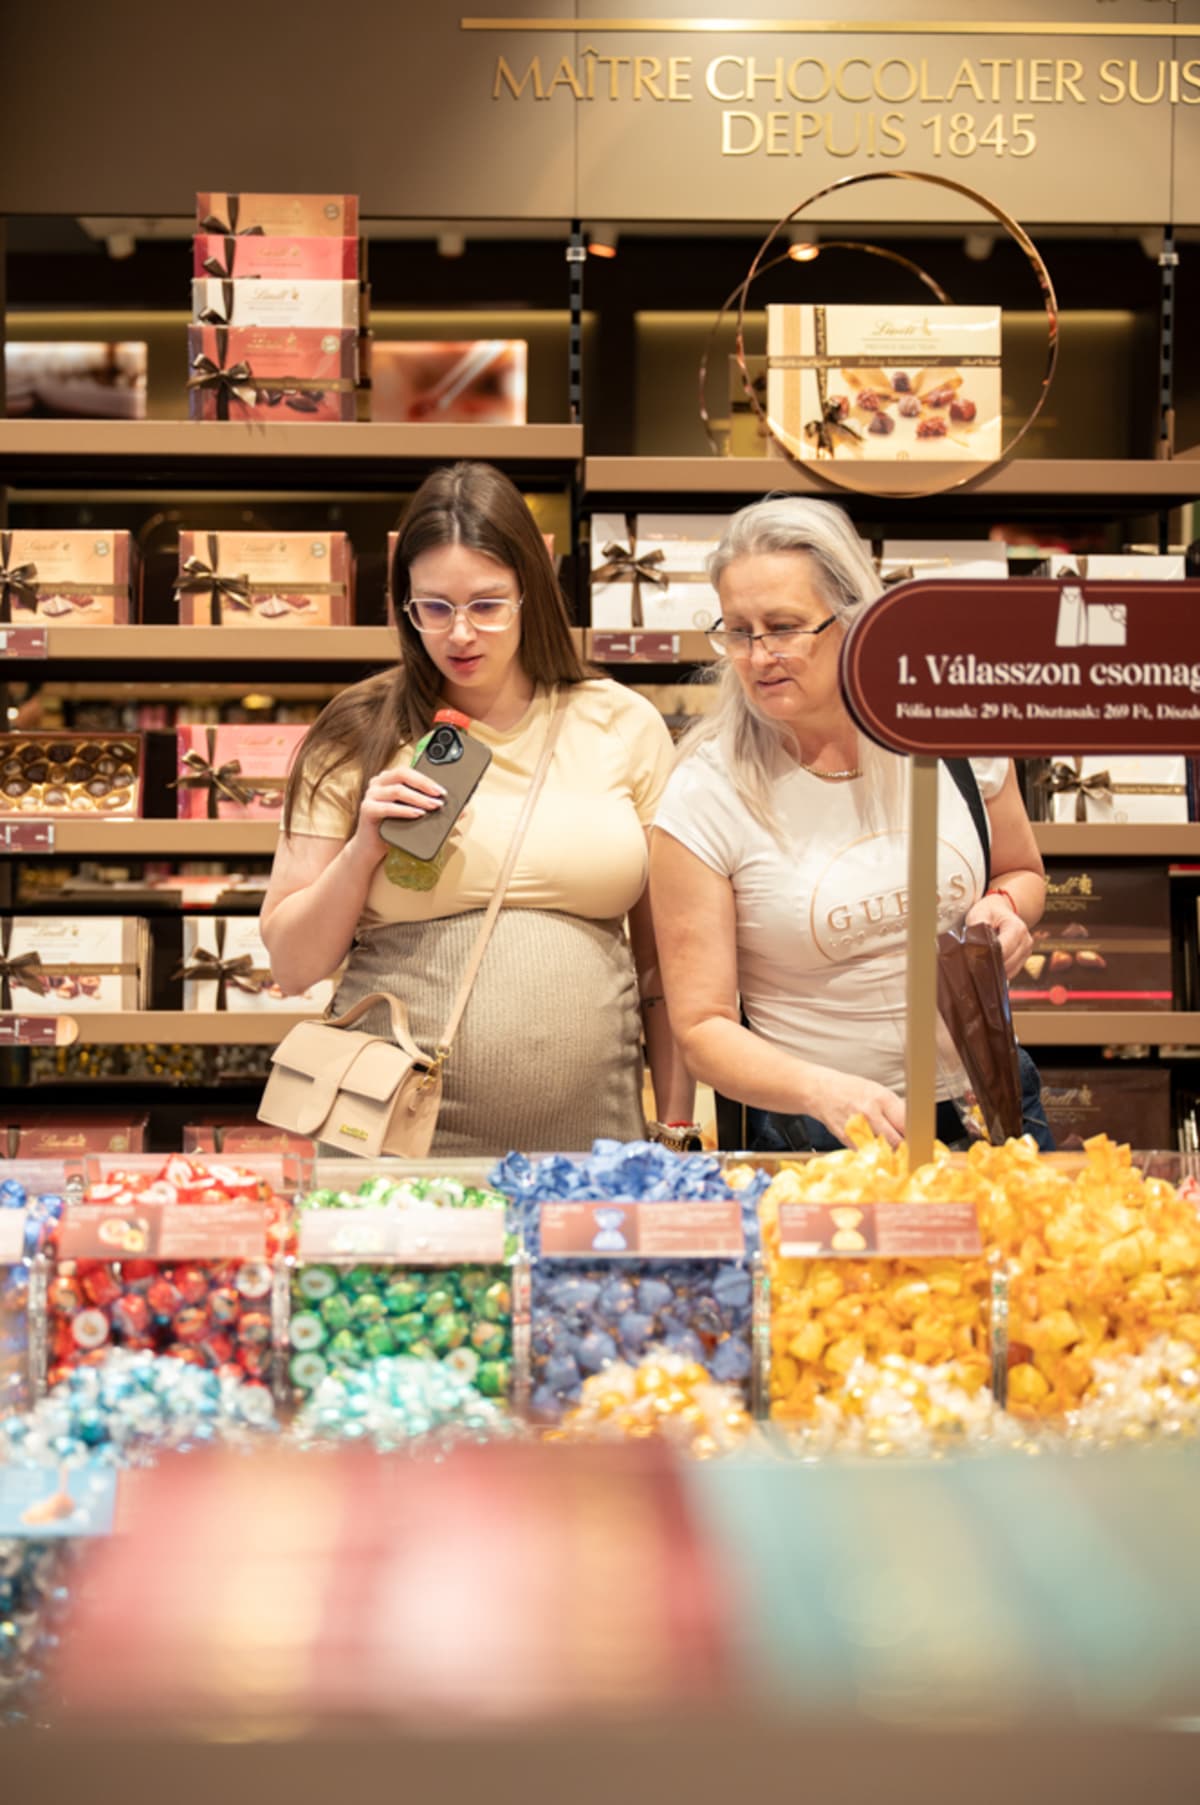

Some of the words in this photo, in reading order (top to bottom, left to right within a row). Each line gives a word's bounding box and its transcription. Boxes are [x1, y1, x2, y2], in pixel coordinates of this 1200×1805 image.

[493, 45, 693, 101] MAÎTRE
[705, 55, 1087, 103] CHOCOLATIER
[1098, 59, 1200, 105] SUIS
[720, 110, 907, 157] DEPUIS
[921, 112, 1037, 157] 1845
[898, 655, 917, 686] 1.
[926, 654, 1081, 686] Válasszon
[934, 703, 978, 719] tasak:
[980, 704, 999, 719] 29
[1002, 703, 1023, 720] Ft,
[1132, 704, 1153, 720] Ft,
[827, 874, 966, 932] GUES
